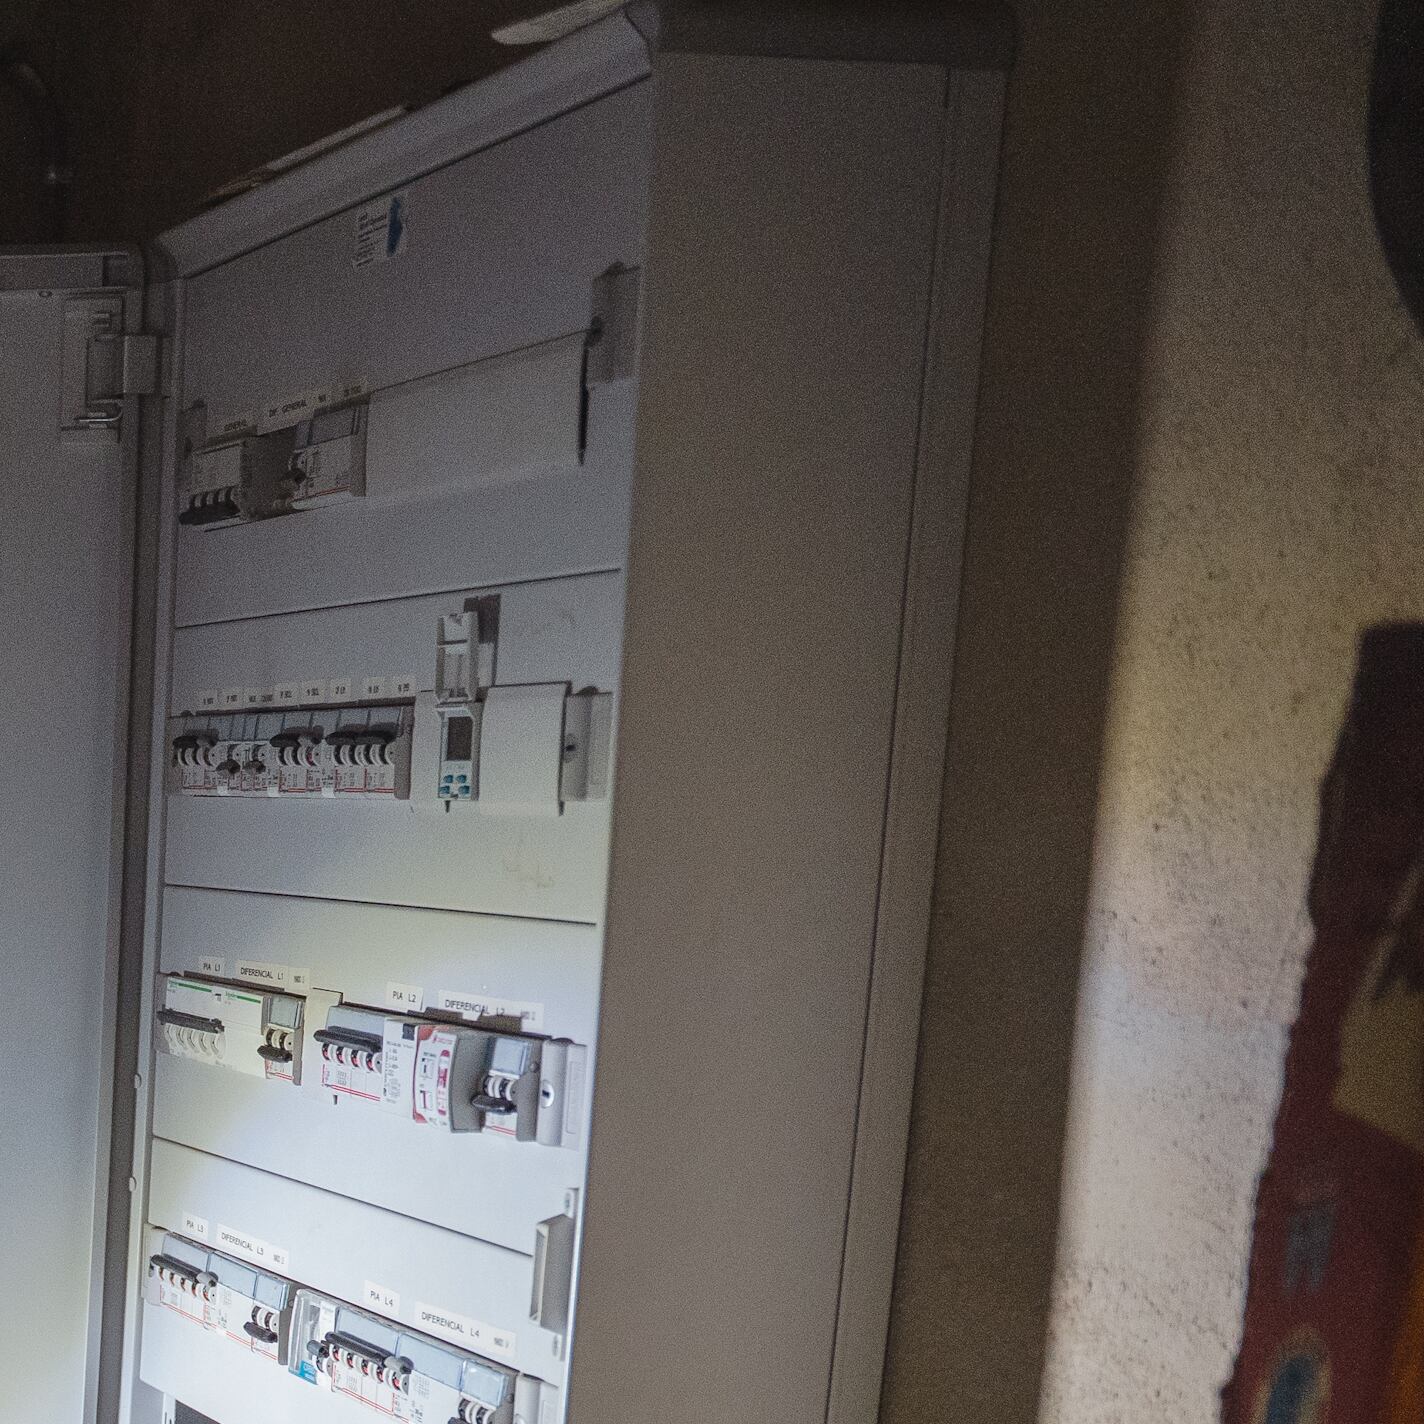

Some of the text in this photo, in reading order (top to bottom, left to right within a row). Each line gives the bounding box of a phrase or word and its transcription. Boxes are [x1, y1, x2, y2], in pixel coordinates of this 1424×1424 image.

[240, 967, 274, 980] DIFERENCIAL
[392, 990, 417, 1003] PIA L2
[444, 999, 490, 1015] DIFERENCIAL
[221, 1232, 254, 1252] DIFERENCIAL
[369, 1290, 394, 1307] PIA L4
[421, 1311, 480, 1337] DIFERENCIAL L4
